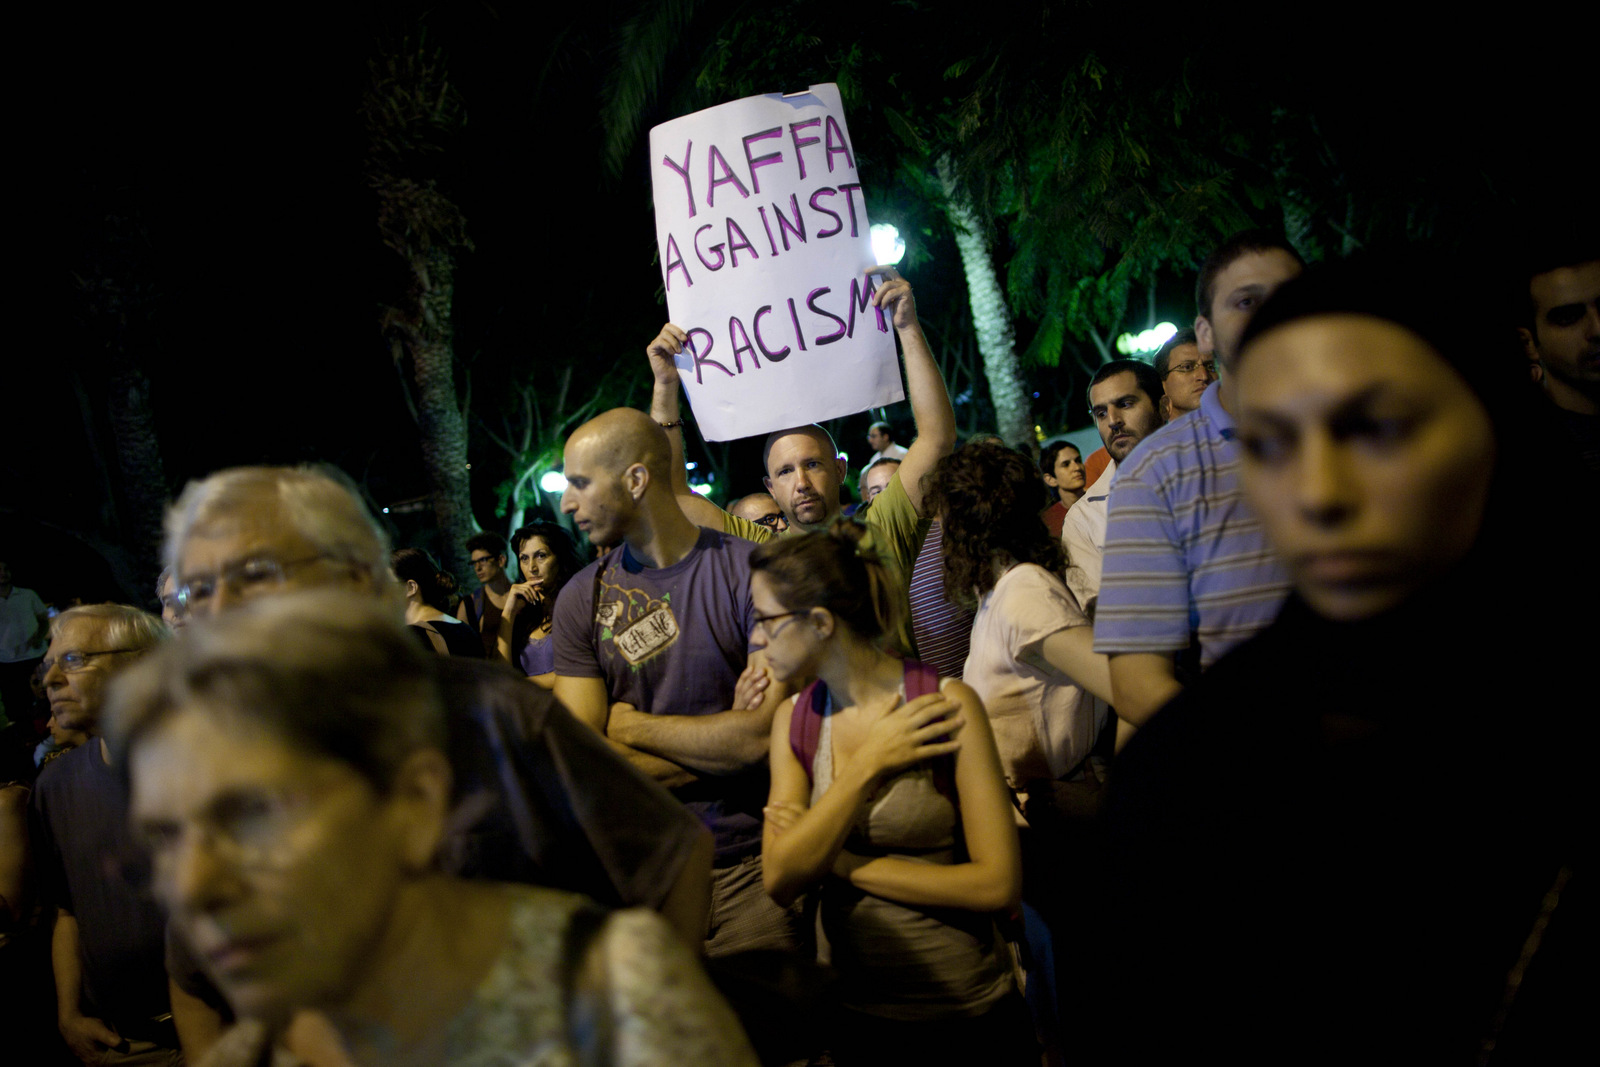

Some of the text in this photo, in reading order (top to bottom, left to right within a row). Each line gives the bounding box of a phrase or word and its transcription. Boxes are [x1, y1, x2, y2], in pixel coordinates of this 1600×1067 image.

[663, 115, 854, 219] YAFFA
[666, 183, 861, 291] AGAINST
[686, 274, 888, 384] RACISM
